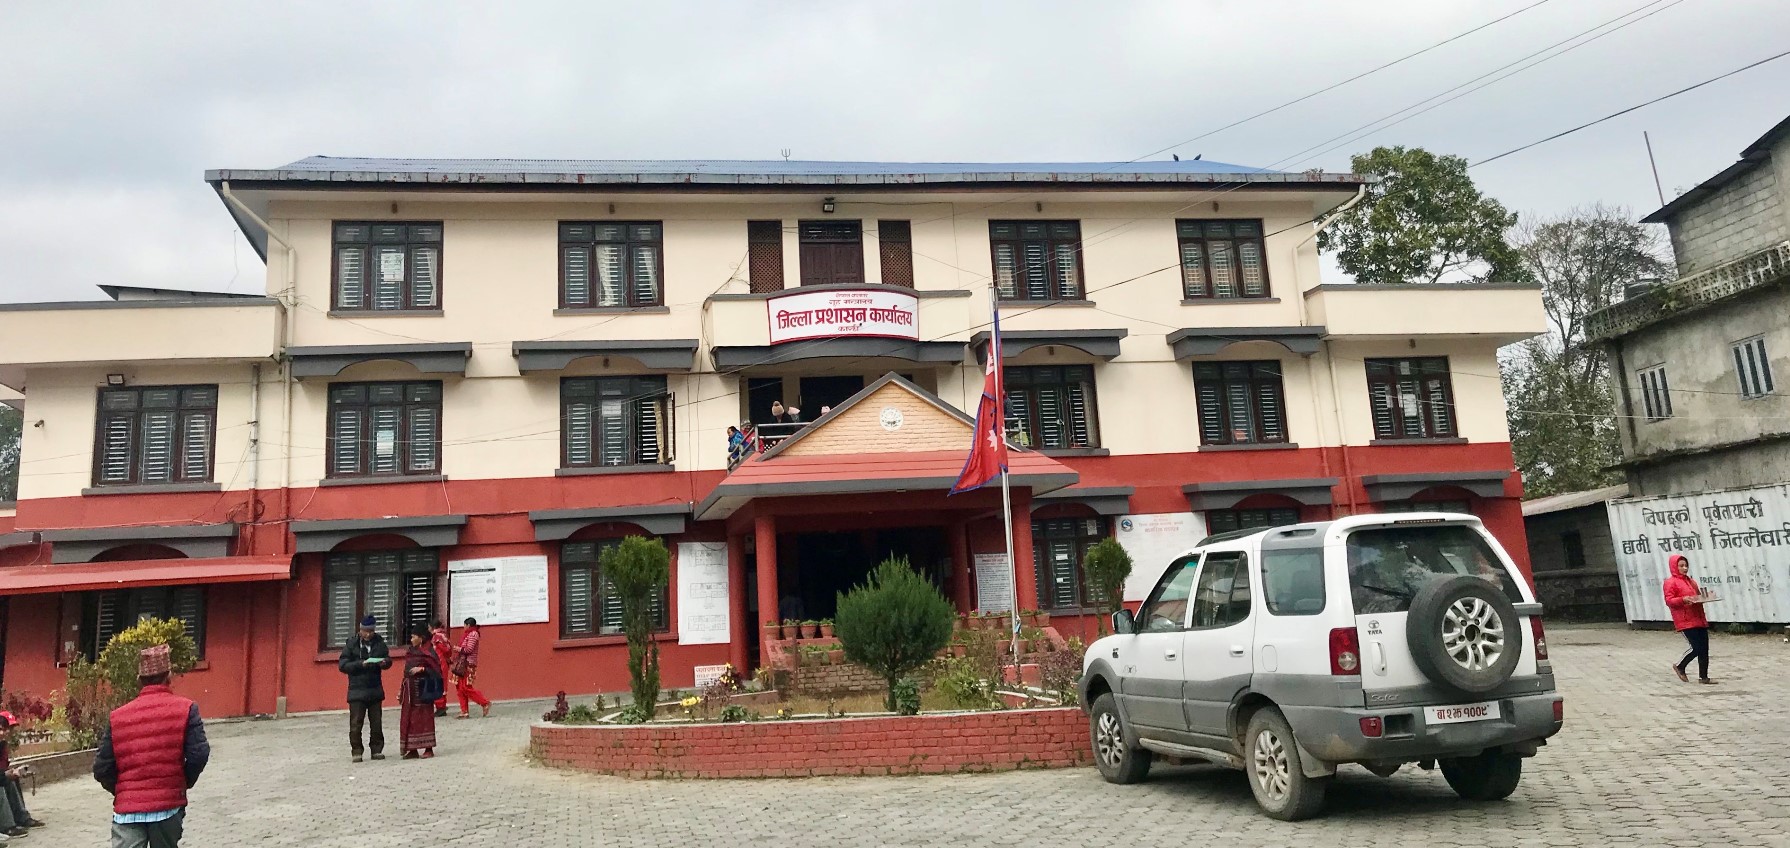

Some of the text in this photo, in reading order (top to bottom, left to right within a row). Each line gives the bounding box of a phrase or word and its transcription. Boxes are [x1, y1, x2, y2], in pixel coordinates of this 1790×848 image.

[776, 304, 913, 330] जिल्ला प्रशासन कार्यालय
[1622, 533, 1651, 555] हामी
[1656, 530, 1703, 553] सबैको
